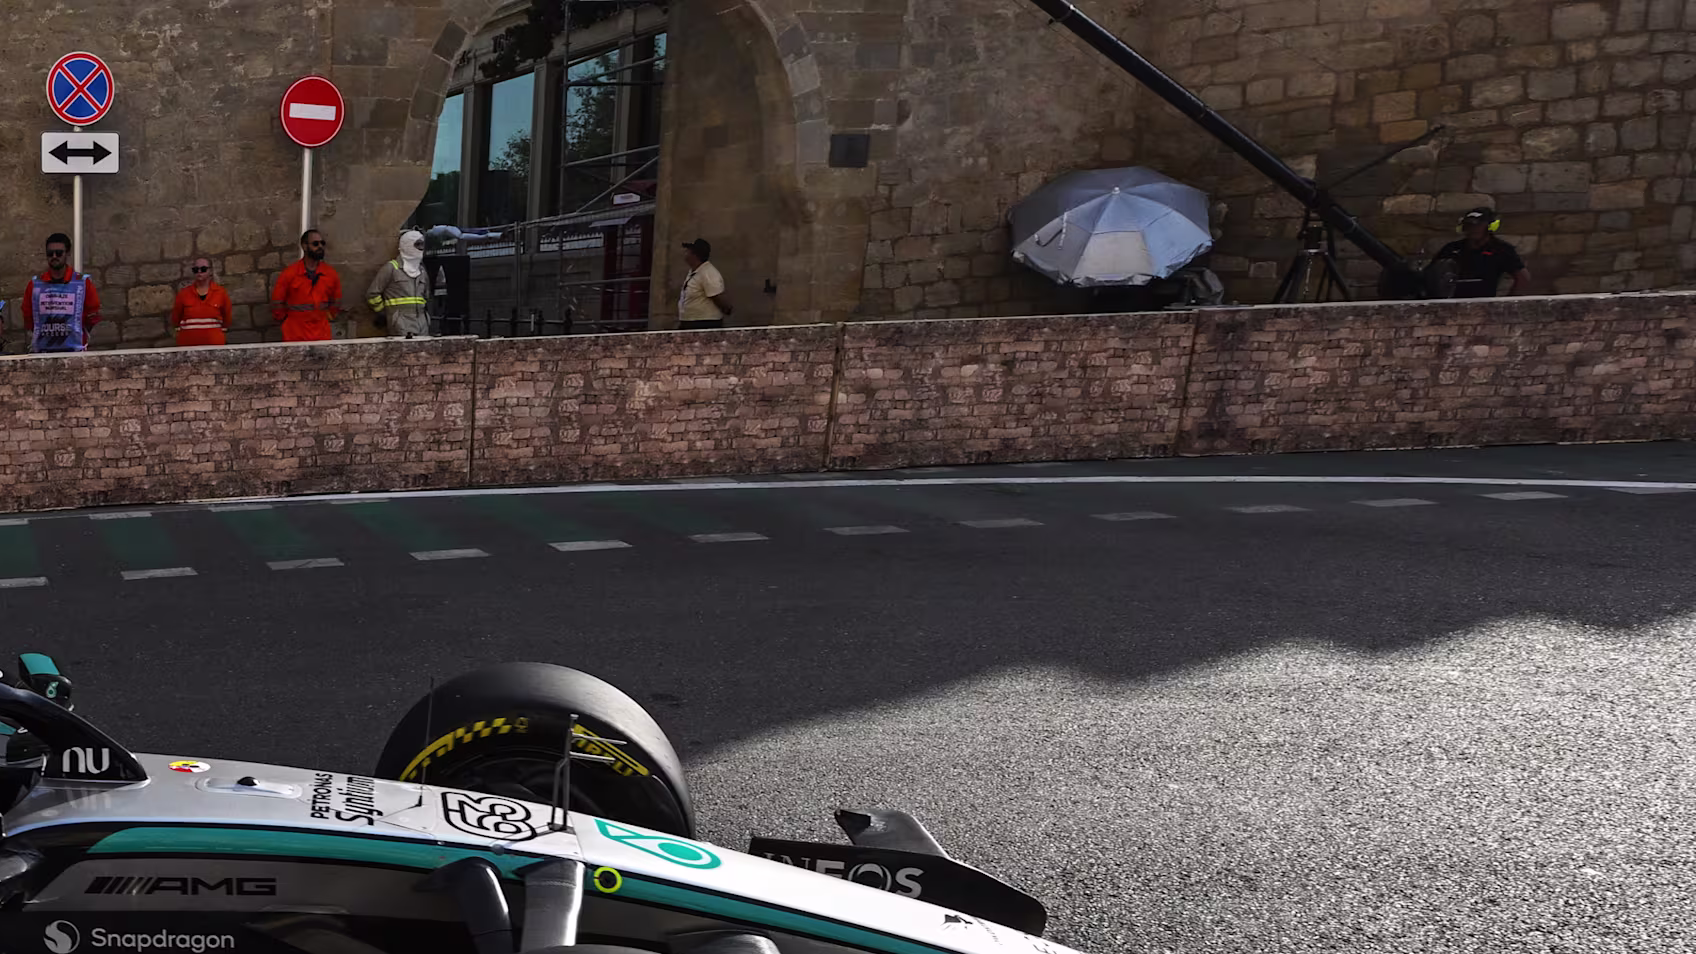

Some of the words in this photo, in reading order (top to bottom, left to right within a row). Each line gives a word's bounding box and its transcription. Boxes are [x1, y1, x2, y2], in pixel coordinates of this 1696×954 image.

[310, 772, 334, 820] PETRONAS
[335, 776, 383, 826] Syntium
[441, 791, 535, 842] 63
[91, 928, 235, 953] Snapdragon
